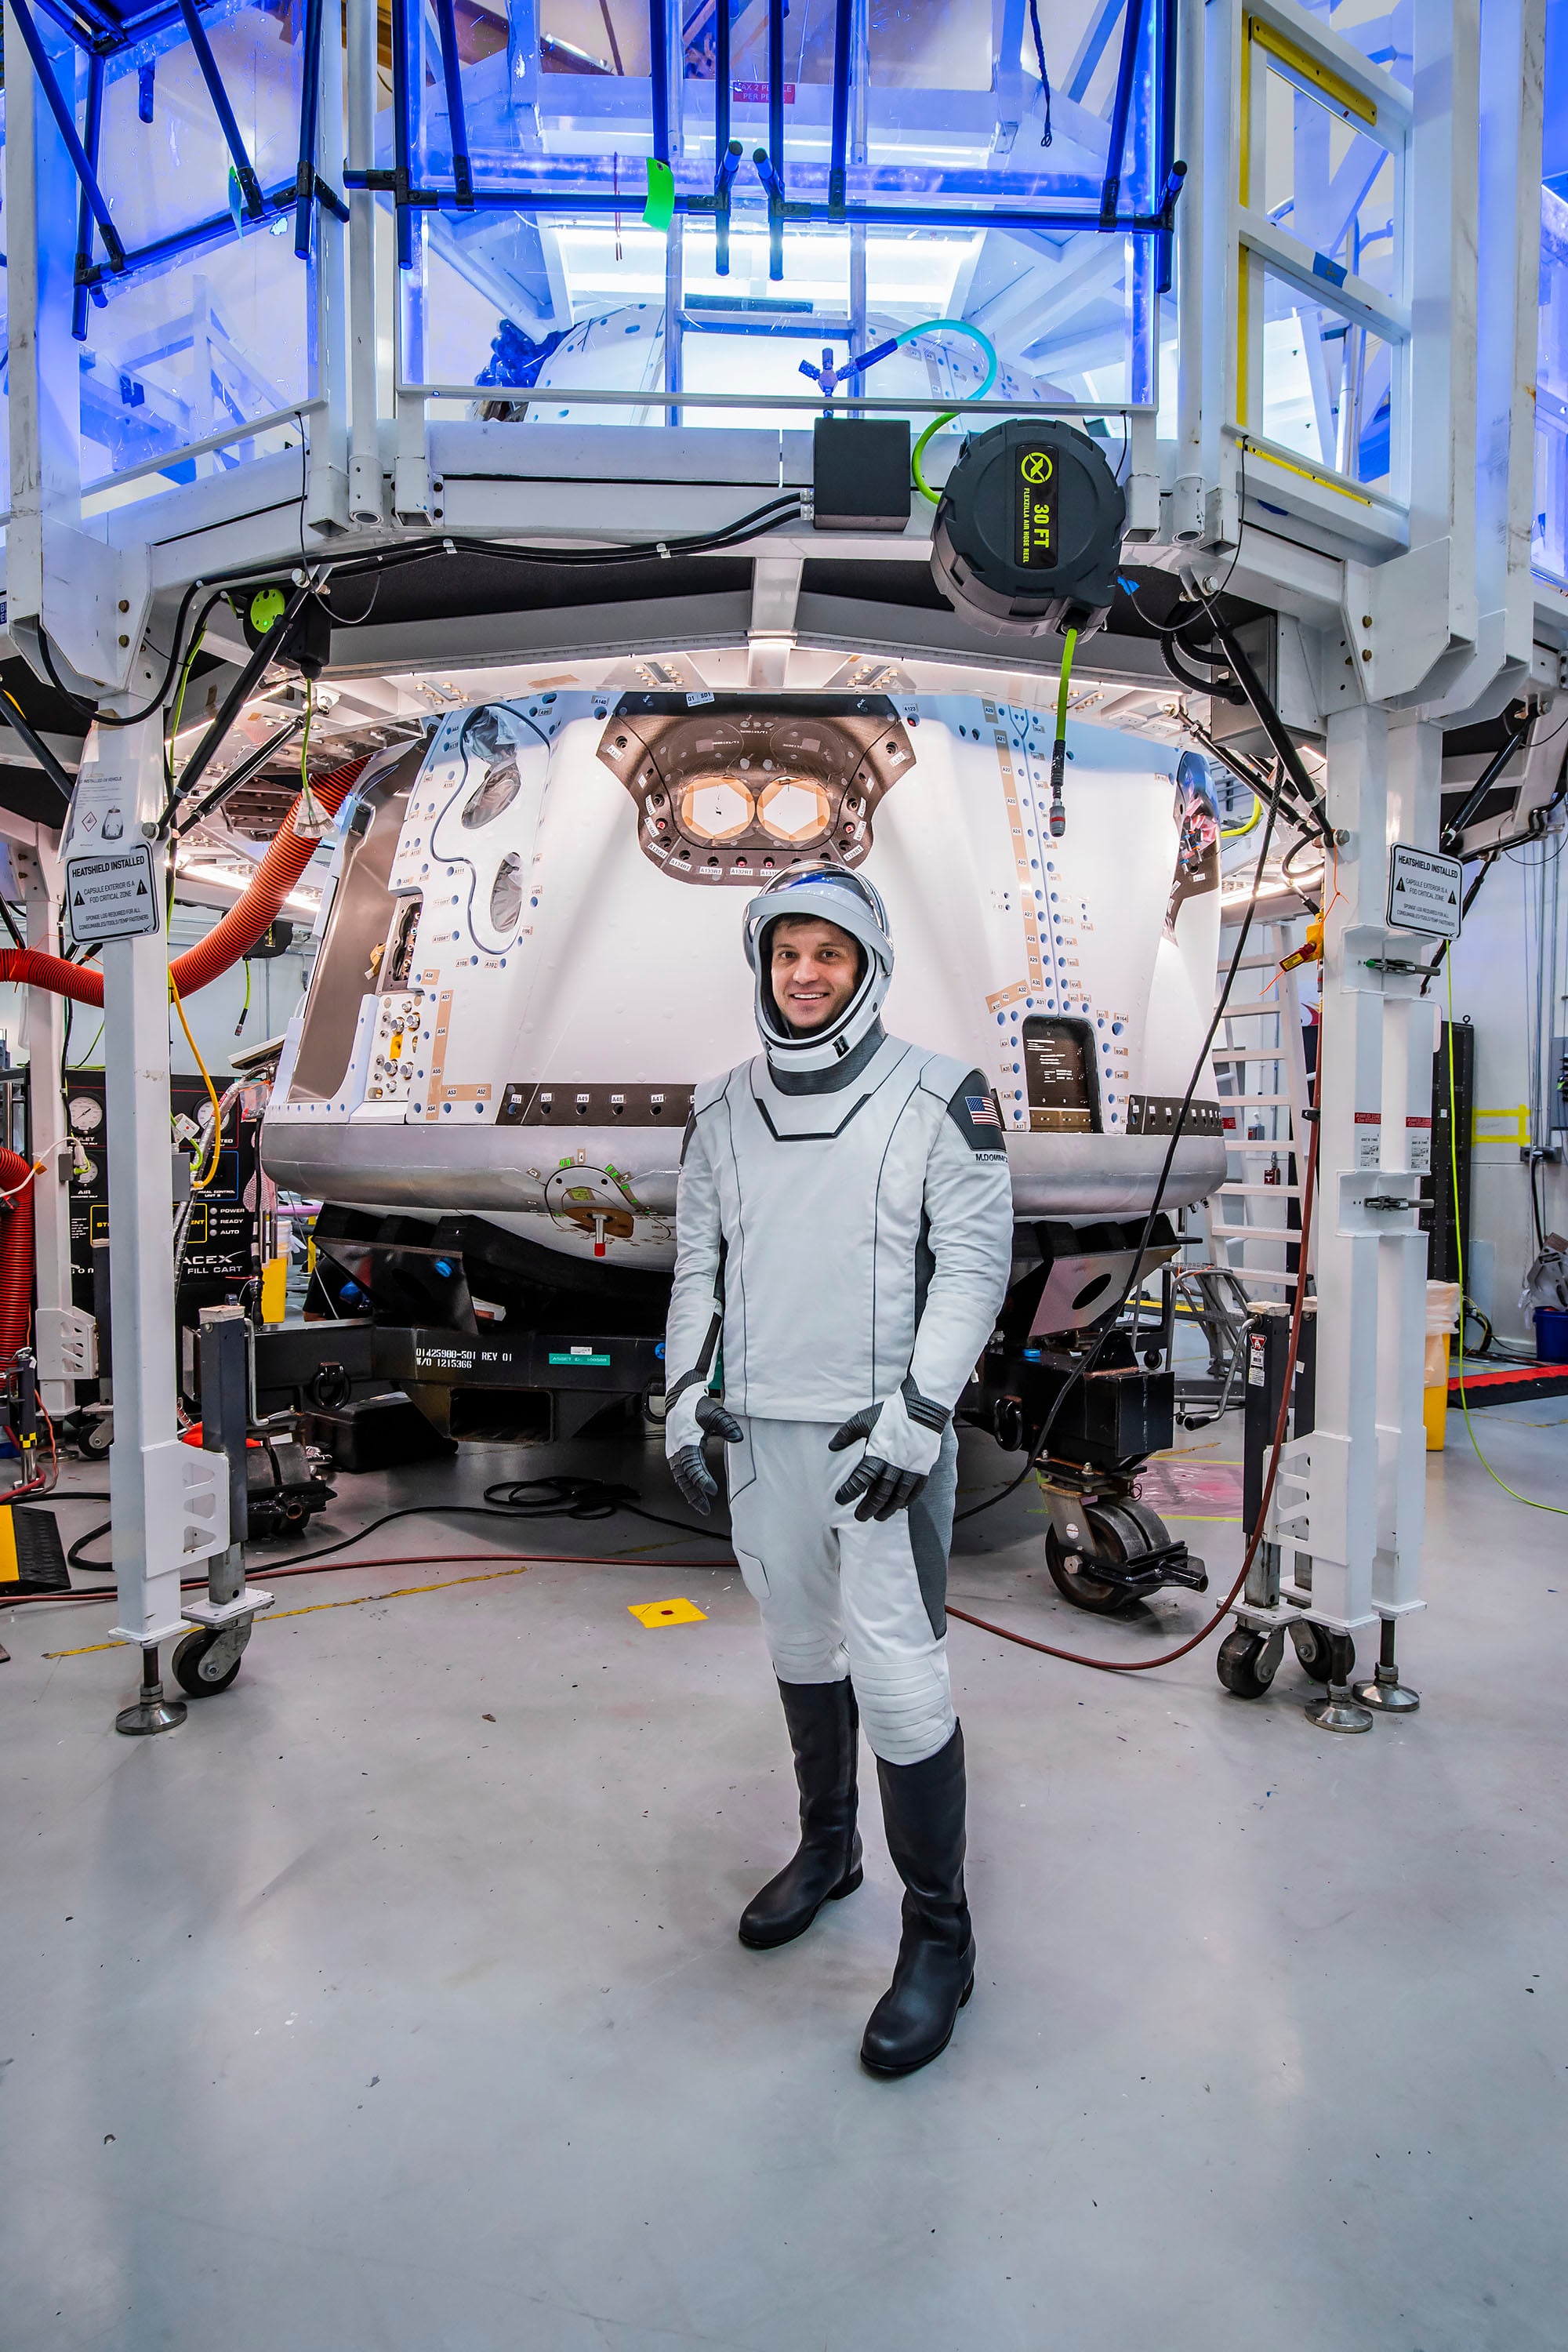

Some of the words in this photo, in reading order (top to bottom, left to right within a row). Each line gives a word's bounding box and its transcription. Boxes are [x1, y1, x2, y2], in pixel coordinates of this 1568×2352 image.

[1034, 505, 1049, 524] 30
[1034, 528, 1049, 548] FT
[72, 862, 110, 877] HEATSHIELD
[111, 855, 145, 870] INSTALLED
[1398, 855, 1431, 871] HEATSHIELD
[1431, 864, 1457, 878] INSTALLED
[83, 885, 104, 895] CAPSULE
[104, 882, 126, 892] EXTERIOR
[1405, 878, 1423, 888] CAPSULE
[100, 893, 119, 902] CRITICAL
[437, 1358, 472, 1369] 1215366
[481, 1352, 498, 1361] REV
[502, 1352, 512, 1362] 01
